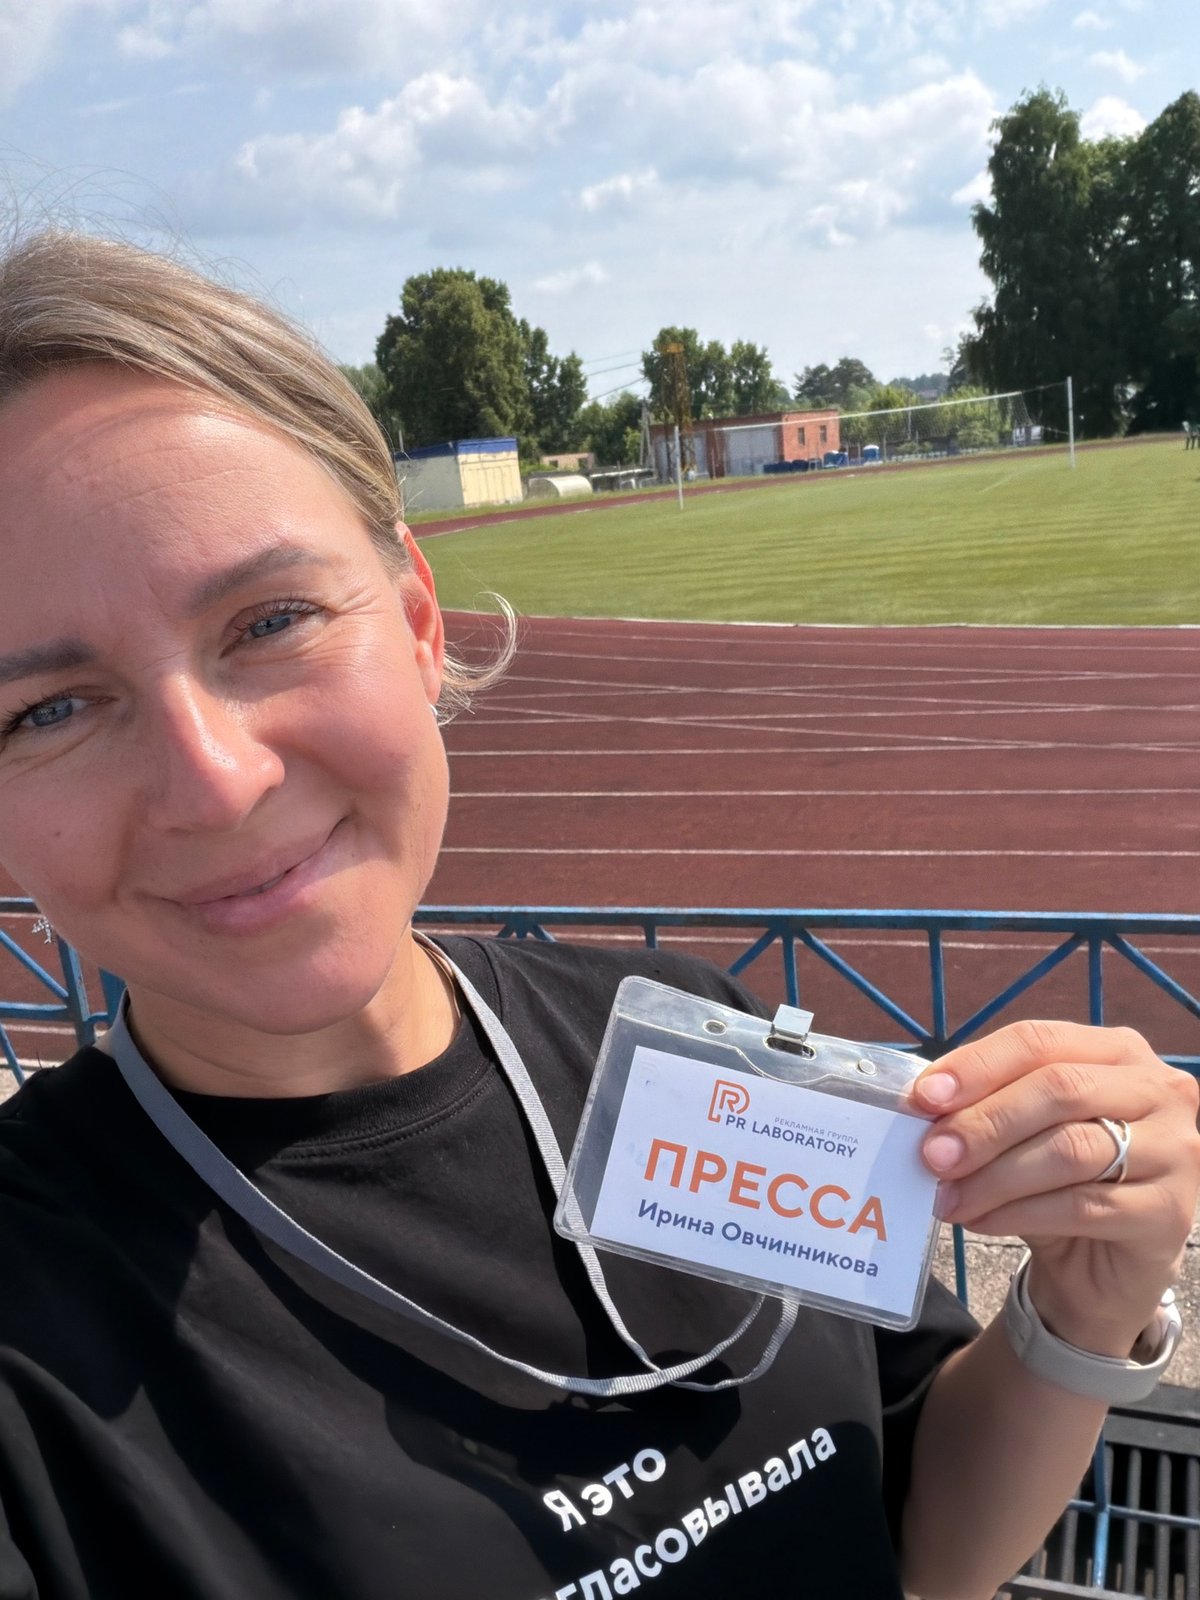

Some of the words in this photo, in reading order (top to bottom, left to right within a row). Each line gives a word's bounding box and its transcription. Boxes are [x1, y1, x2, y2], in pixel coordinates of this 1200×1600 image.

[725, 1114, 746, 1131] PR
[751, 1121, 858, 1159] LABORATORY
[774, 1116, 825, 1136] РЕКЛАМНАЯ
[827, 1130, 859, 1145] ГРУППА
[643, 1138, 888, 1243] ПРЕССА
[637, 1199, 715, 1237] Ирина
[721, 1221, 880, 1278] Овчинникова
[539, 1427, 837, 1600] гласовывала
[543, 1489, 587, 1532] Я
[581, 1448, 667, 1517] это
